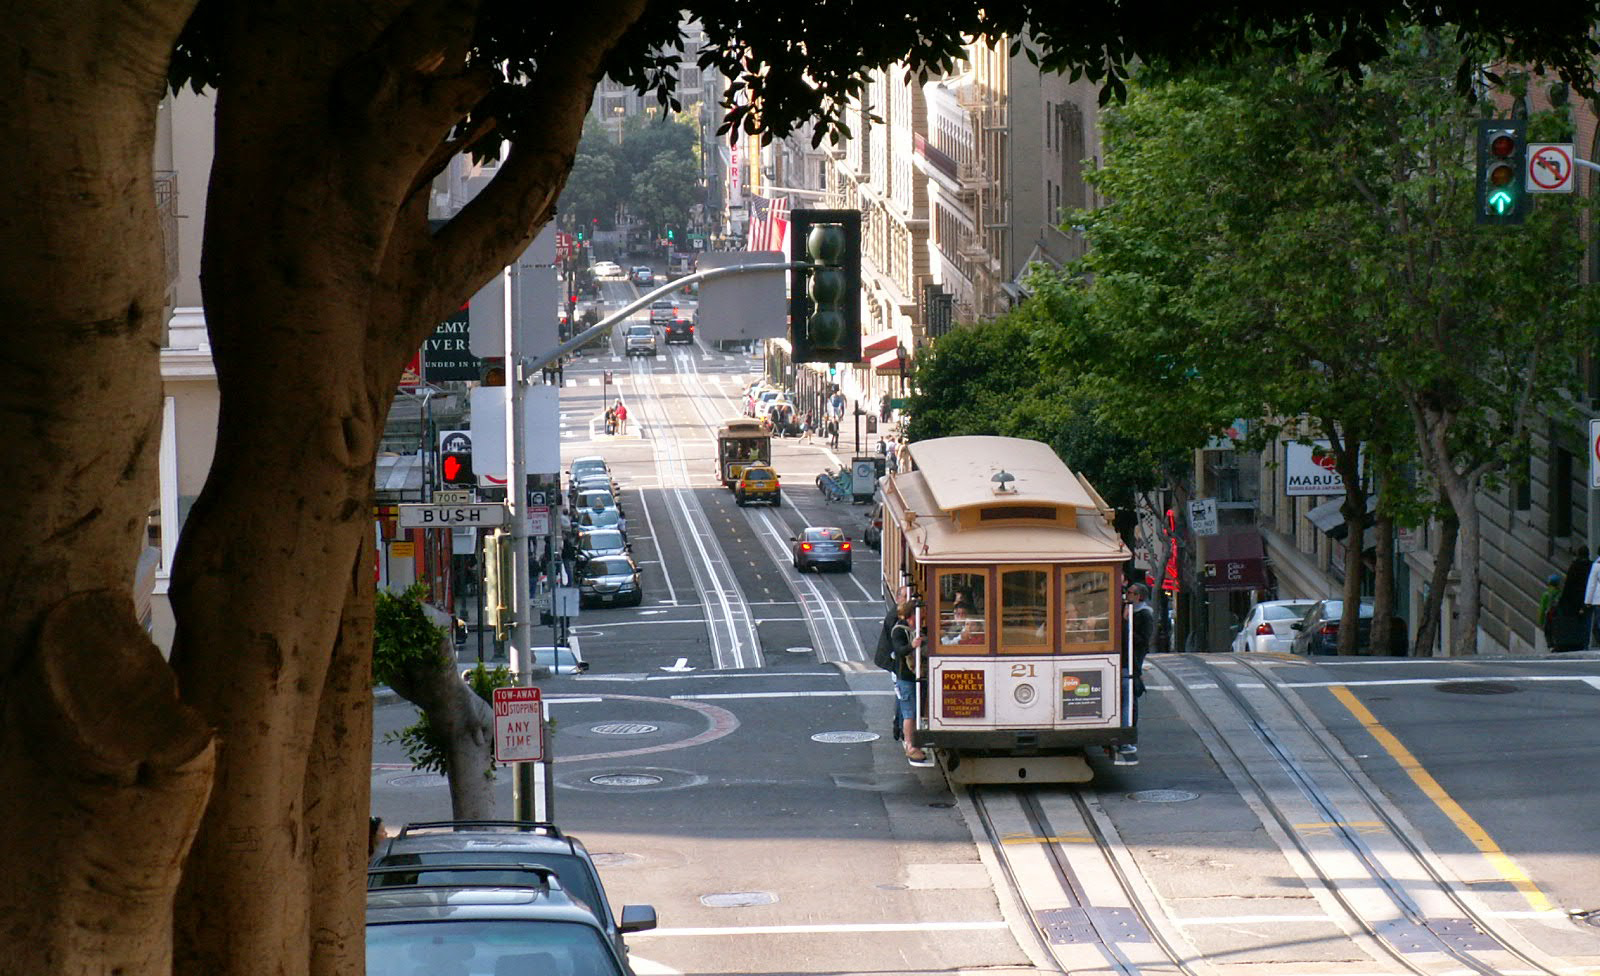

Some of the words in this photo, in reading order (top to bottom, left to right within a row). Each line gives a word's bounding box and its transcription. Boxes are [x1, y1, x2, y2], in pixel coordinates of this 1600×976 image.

[438, 494, 458, 503] 700
[423, 509, 481, 523] BUSH
[1011, 663, 1037, 678] 21
[496, 690, 537, 700] TOW-AWAY
[495, 701, 508, 716] NO
[509, 703, 538, 714] STOPPING
[507, 721, 530, 734] ANY
[505, 735, 531, 747] TIME
